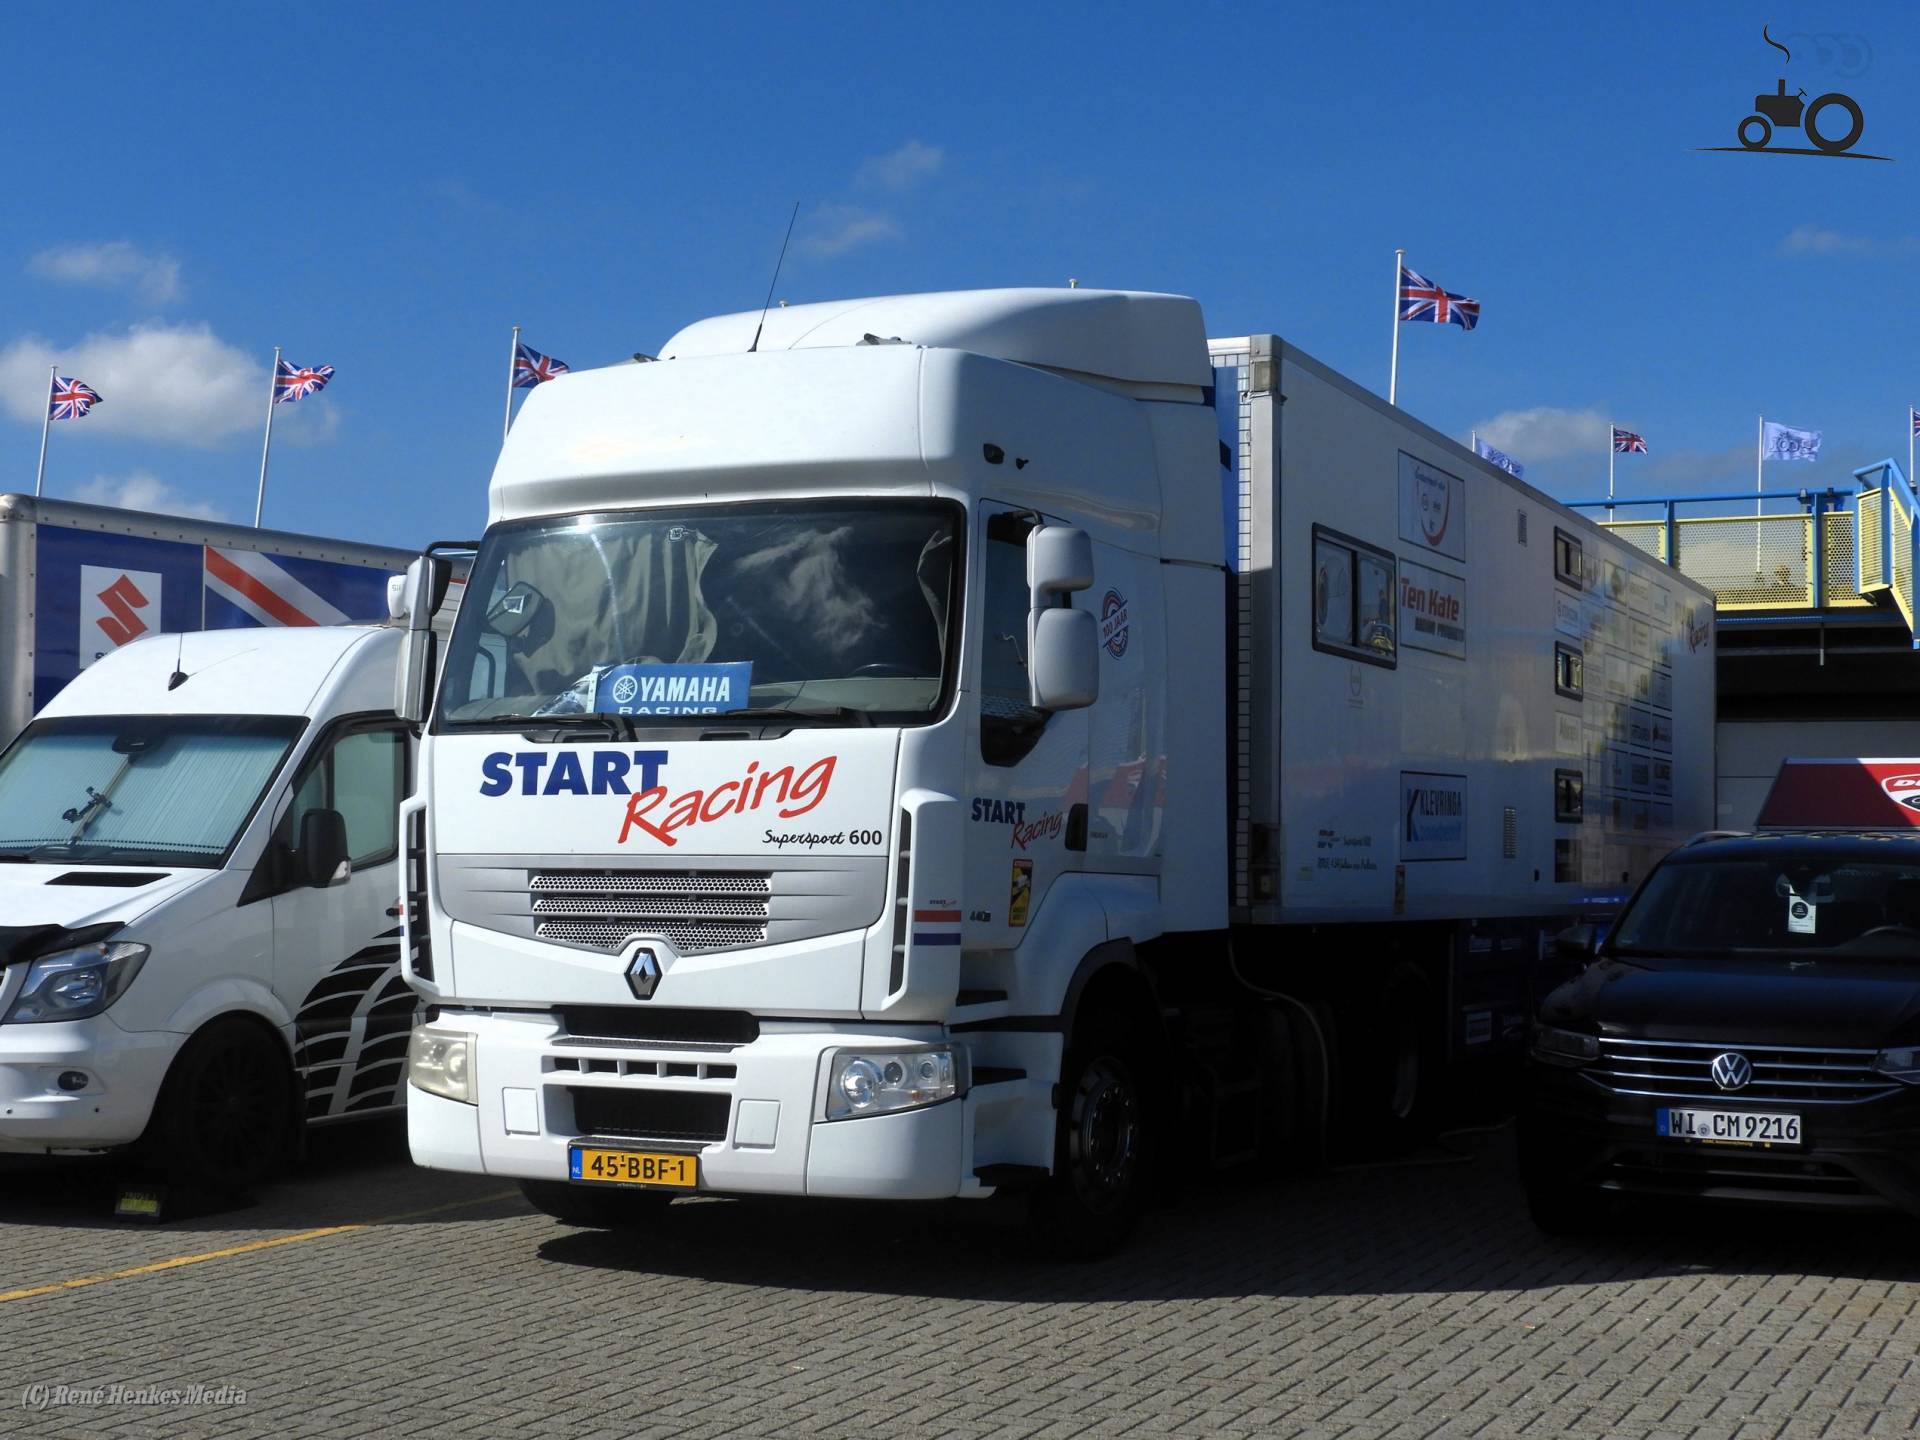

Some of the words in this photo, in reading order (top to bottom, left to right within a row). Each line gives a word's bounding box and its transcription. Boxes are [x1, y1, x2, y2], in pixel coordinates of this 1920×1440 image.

[1400, 577, 1425, 612] Ten
[1429, 588, 1459, 621] Kate
[640, 677, 730, 702] YAMAHA
[619, 706, 717, 715] RACING
[479, 750, 668, 796] START
[618, 755, 837, 847] Racing
[971, 797, 1025, 824] START
[762, 829, 845, 850] Supersport
[849, 830, 882, 846] 600
[1011, 811, 1063, 851] Racing
[1671, 1112, 1696, 1135] WI
[1713, 1114, 1740, 1137] CM
[1745, 1116, 1798, 1140] 9216
